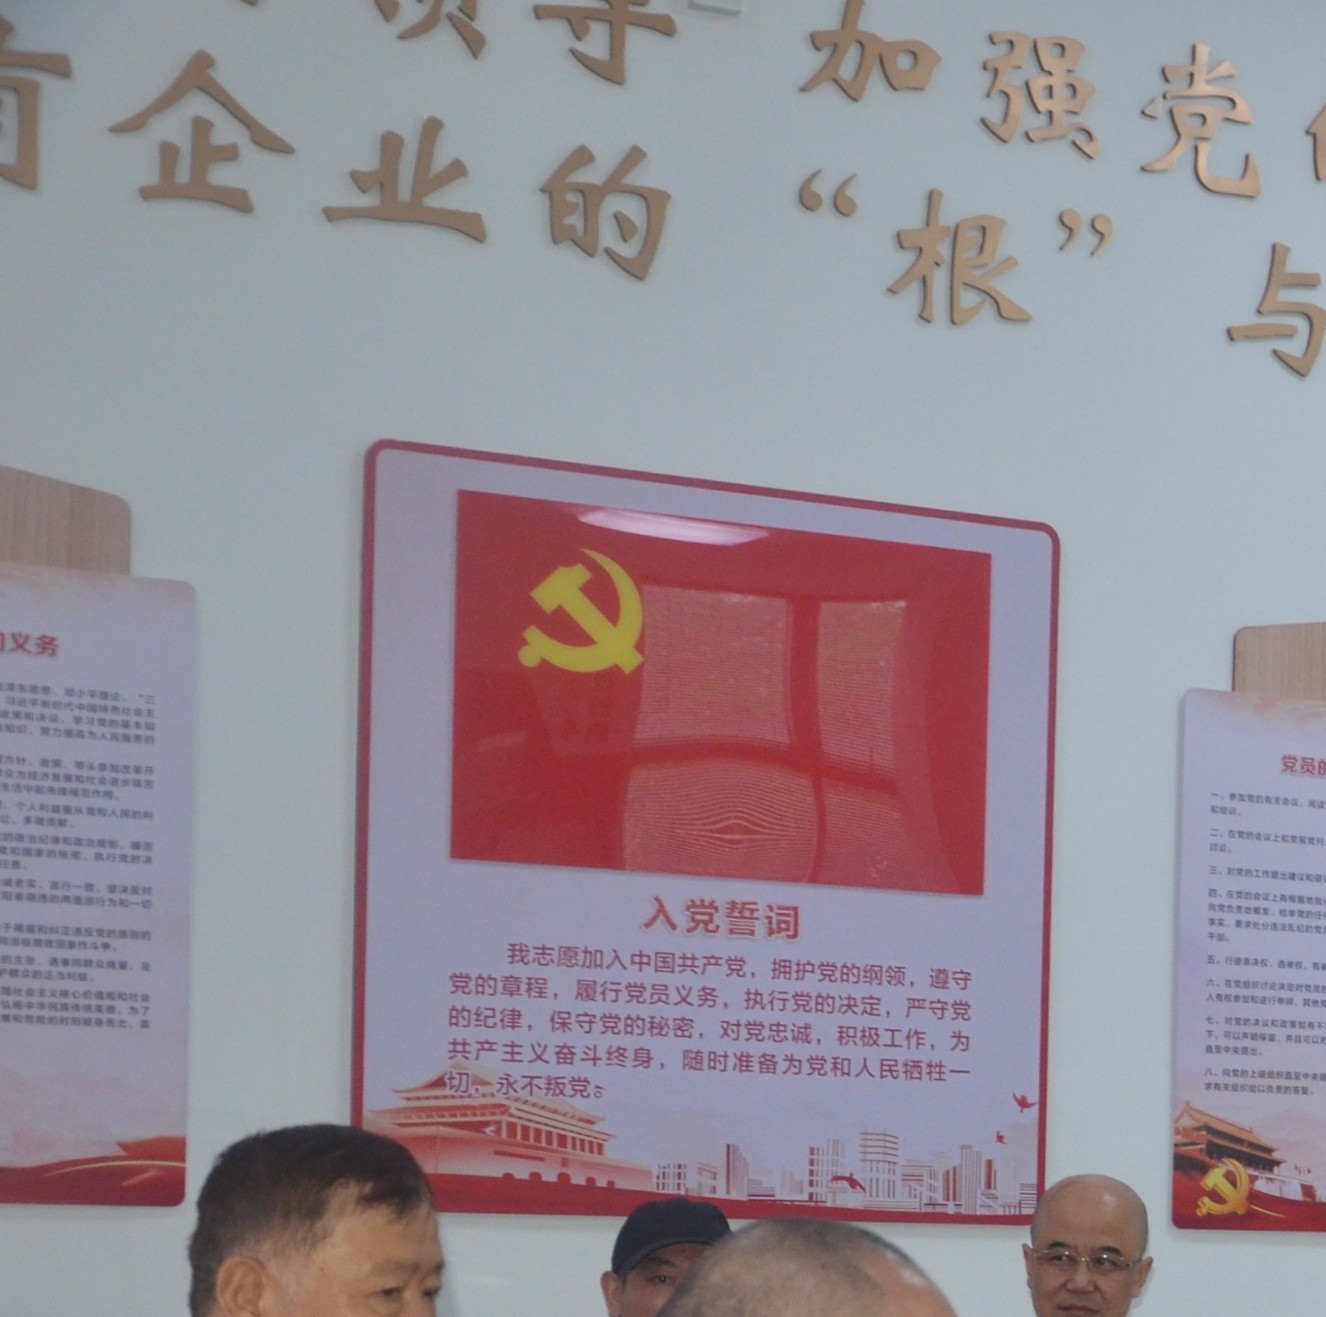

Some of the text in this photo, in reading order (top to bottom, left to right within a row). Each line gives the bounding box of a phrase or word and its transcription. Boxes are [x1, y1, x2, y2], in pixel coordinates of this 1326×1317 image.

[641, 895, 801, 940] 入党誓词
[507, 942, 972, 991] 我志愿加入中国共产党，拥护党的纲领，遵守
[449, 972, 971, 1022] 党的章程，履行党员义务，执行党的决定，严守党
[448, 1004, 970, 1052] 的纪律，保守党的秘密，对党忠诚，积极工作，为
[447, 1038, 970, 1083] 共产主义奋斗终身，随时准备为党和人民牺牲一
